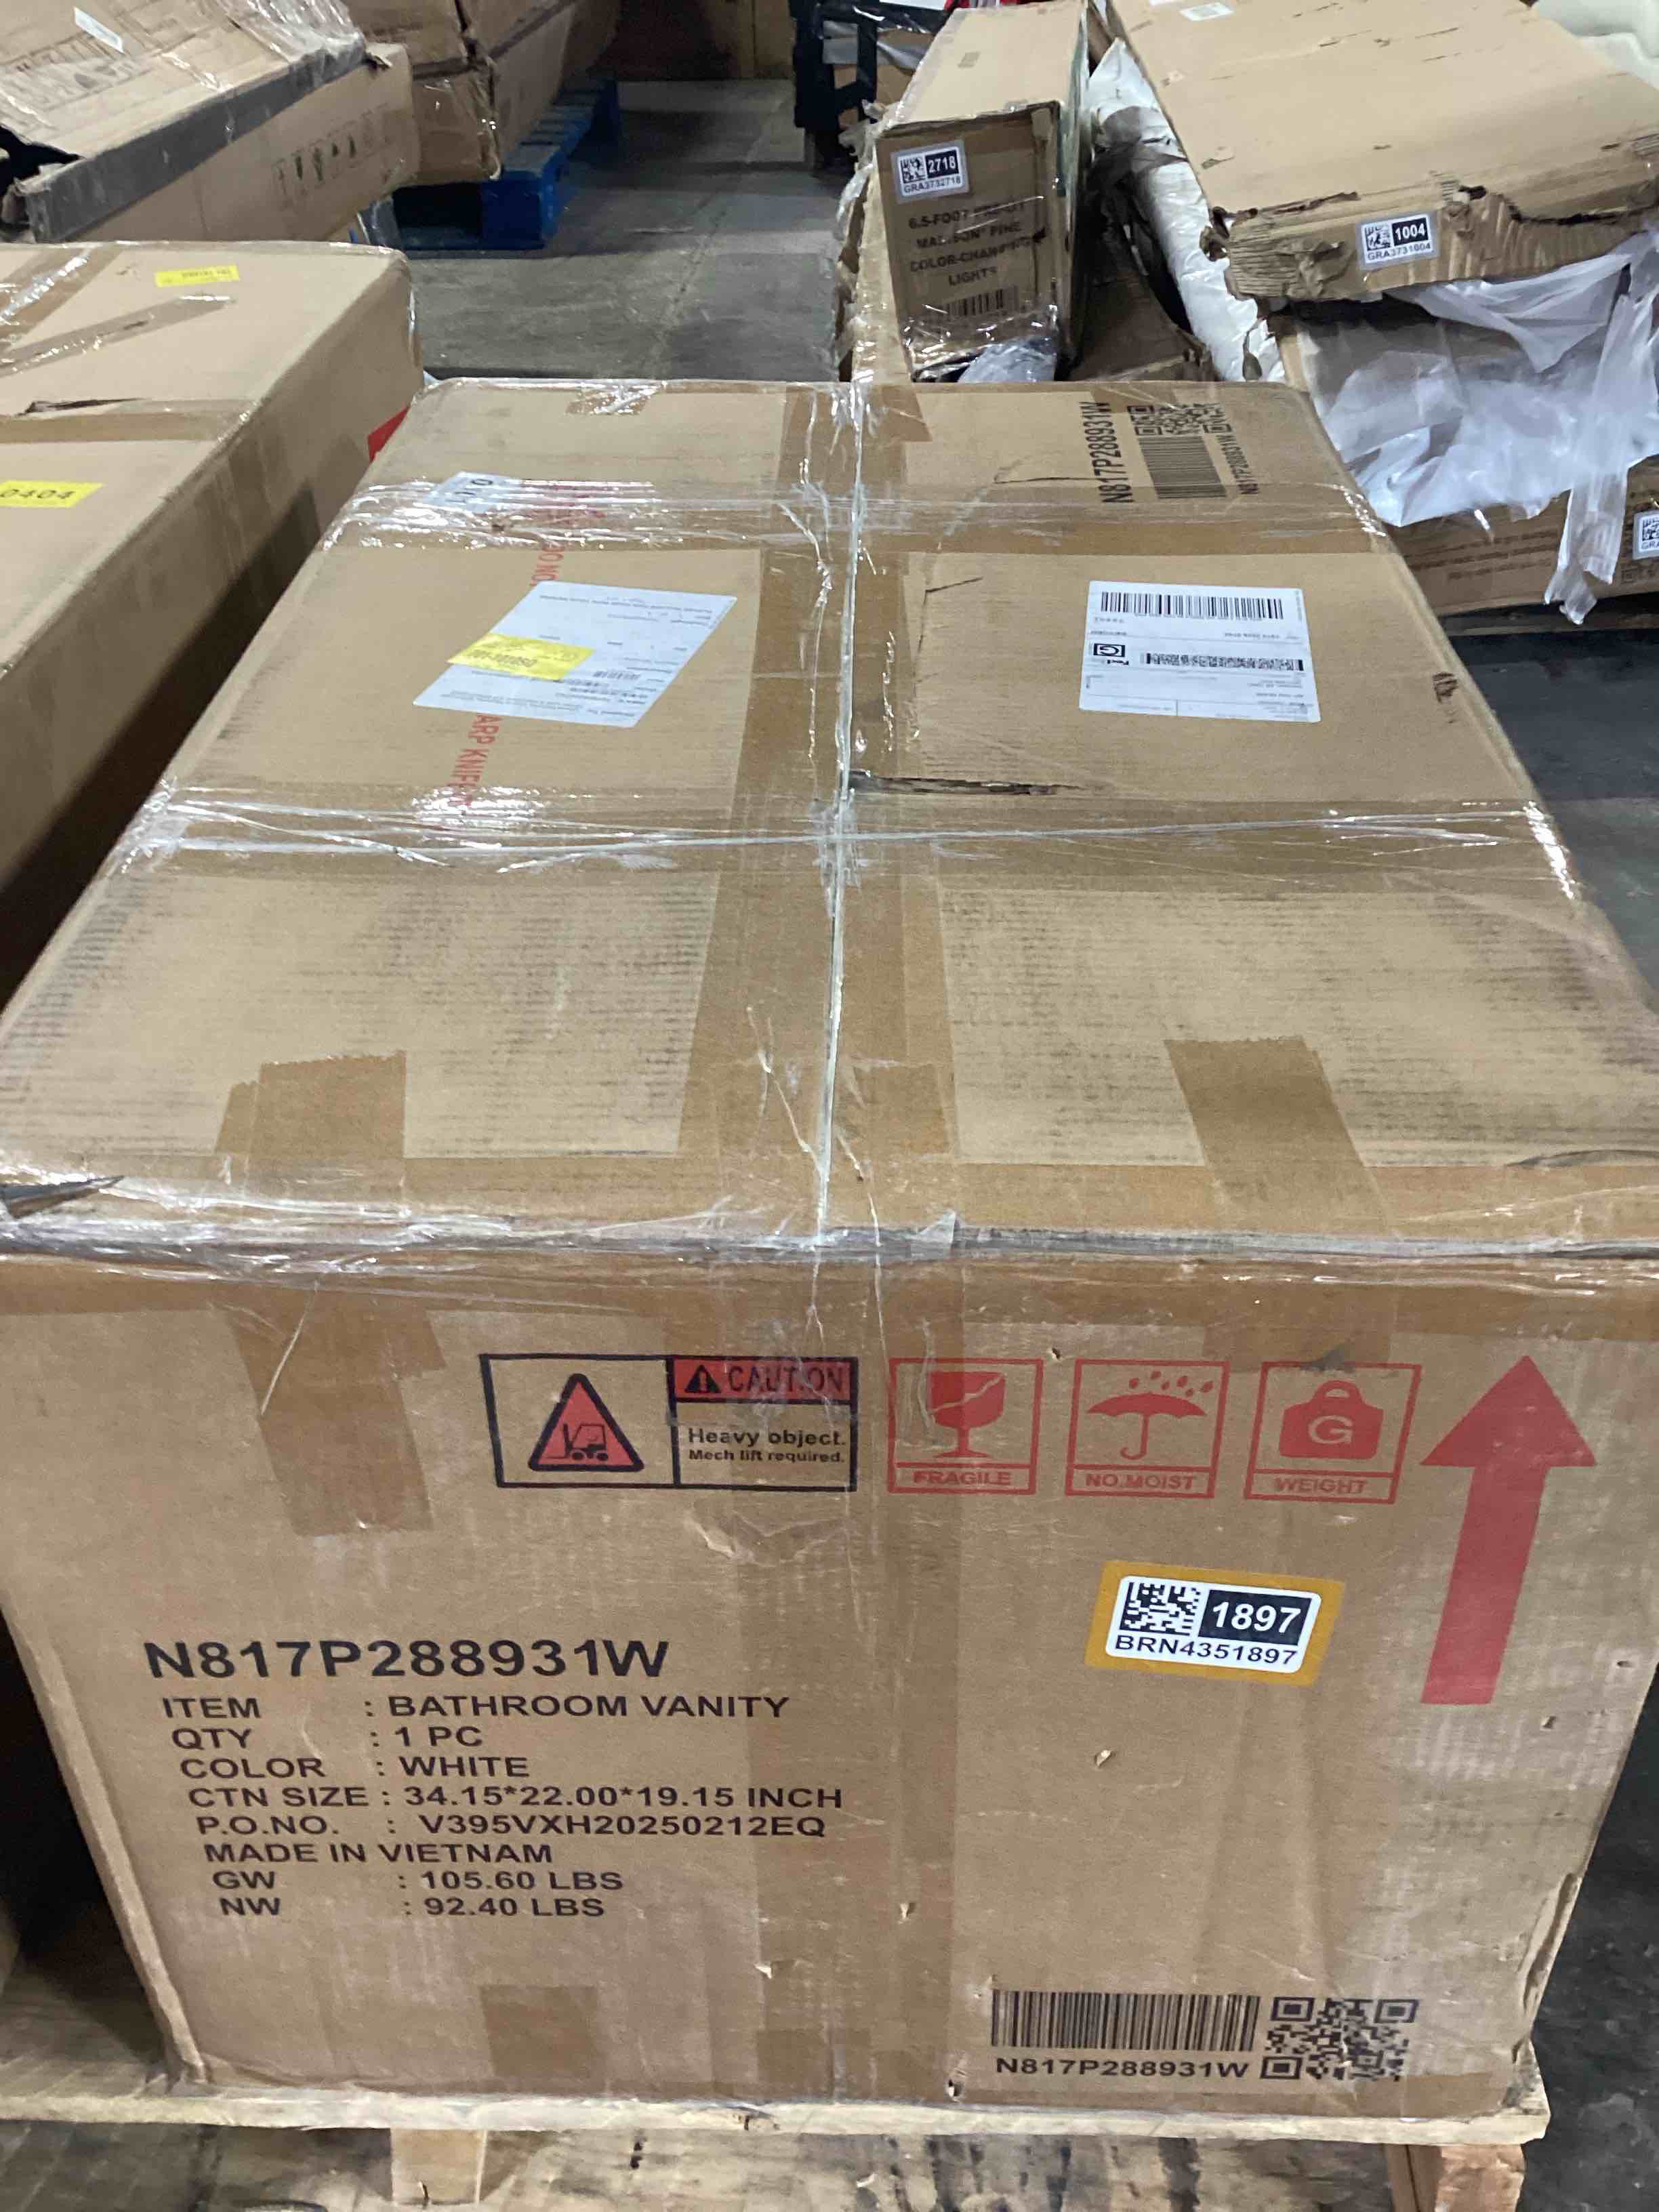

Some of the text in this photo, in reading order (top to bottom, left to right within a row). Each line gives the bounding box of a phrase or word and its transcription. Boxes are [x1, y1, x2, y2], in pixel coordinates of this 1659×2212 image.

[928, 156, 956, 173] 2718
[1395, 223, 1425, 241] 1004
[1079, 401, 1135, 503] N817P288931W
[688, 1427, 846, 1448] Heavy object.
[689, 1449, 845, 1464] Mech lift required.
[913, 1471, 1011, 1486] FRAGILE
[1275, 1477, 1368, 1494] WEIGHT
[1212, 1601, 1301, 1633] 1897
[144, 1639, 670, 1679] N817P288931W
[1115, 1635, 1298, 1665] BRN4351897
[163, 1698, 261, 1719] ITEM
[388, 1696, 628, 1717] BATHROOM
[640, 1696, 790, 1718] VANITY
[171, 1728, 252, 1750] QTY
[395, 1727, 411, 1747] 1
[428, 1726, 483, 1747] PC
[180, 1758, 326, 1779] COLOR
[398, 1756, 530, 1778] WHITE
[188, 1787, 268, 1807] CTN
[282, 1786, 369, 1807] SIZE
[747, 1788, 842, 1809] INCH
[196, 1816, 340, 1836] P.O.NO.
[418, 1815, 825, 1838] V395VXH20250212EQ
[204, 1843, 553, 1864] MADE IN VIETNAM
[212, 1871, 275, 1889] GW
[421, 1871, 535, 1889] 105.60
[549, 1871, 623, 1891] LBS
[219, 1898, 281, 1916] NW
[424, 1898, 518, 1917] 92.40
[531, 1898, 605, 1917] LBS
[996, 2057, 1249, 2078] N817P288931W
